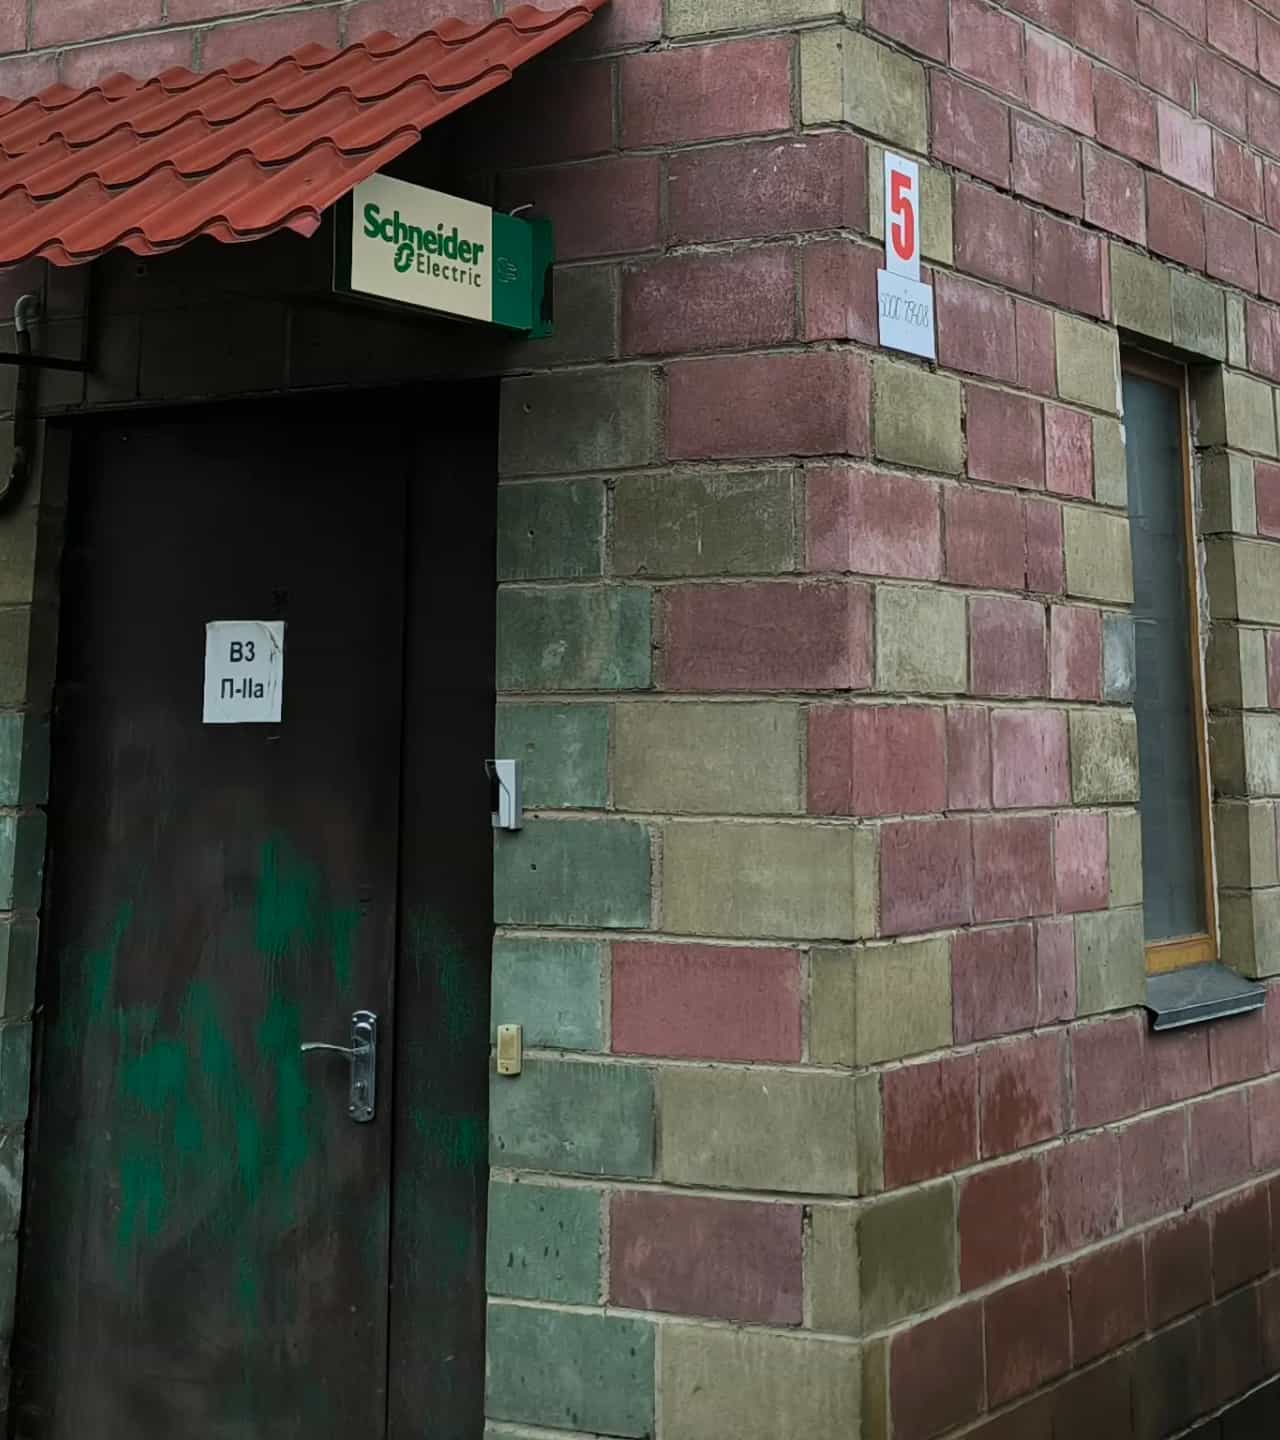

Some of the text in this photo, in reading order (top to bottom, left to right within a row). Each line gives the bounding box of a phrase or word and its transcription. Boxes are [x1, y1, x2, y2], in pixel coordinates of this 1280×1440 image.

[363, 202, 484, 266] Schneider
[890, 169, 915, 261] 5
[416, 252, 482, 288] Electric
[229, 640, 256, 663] В3
